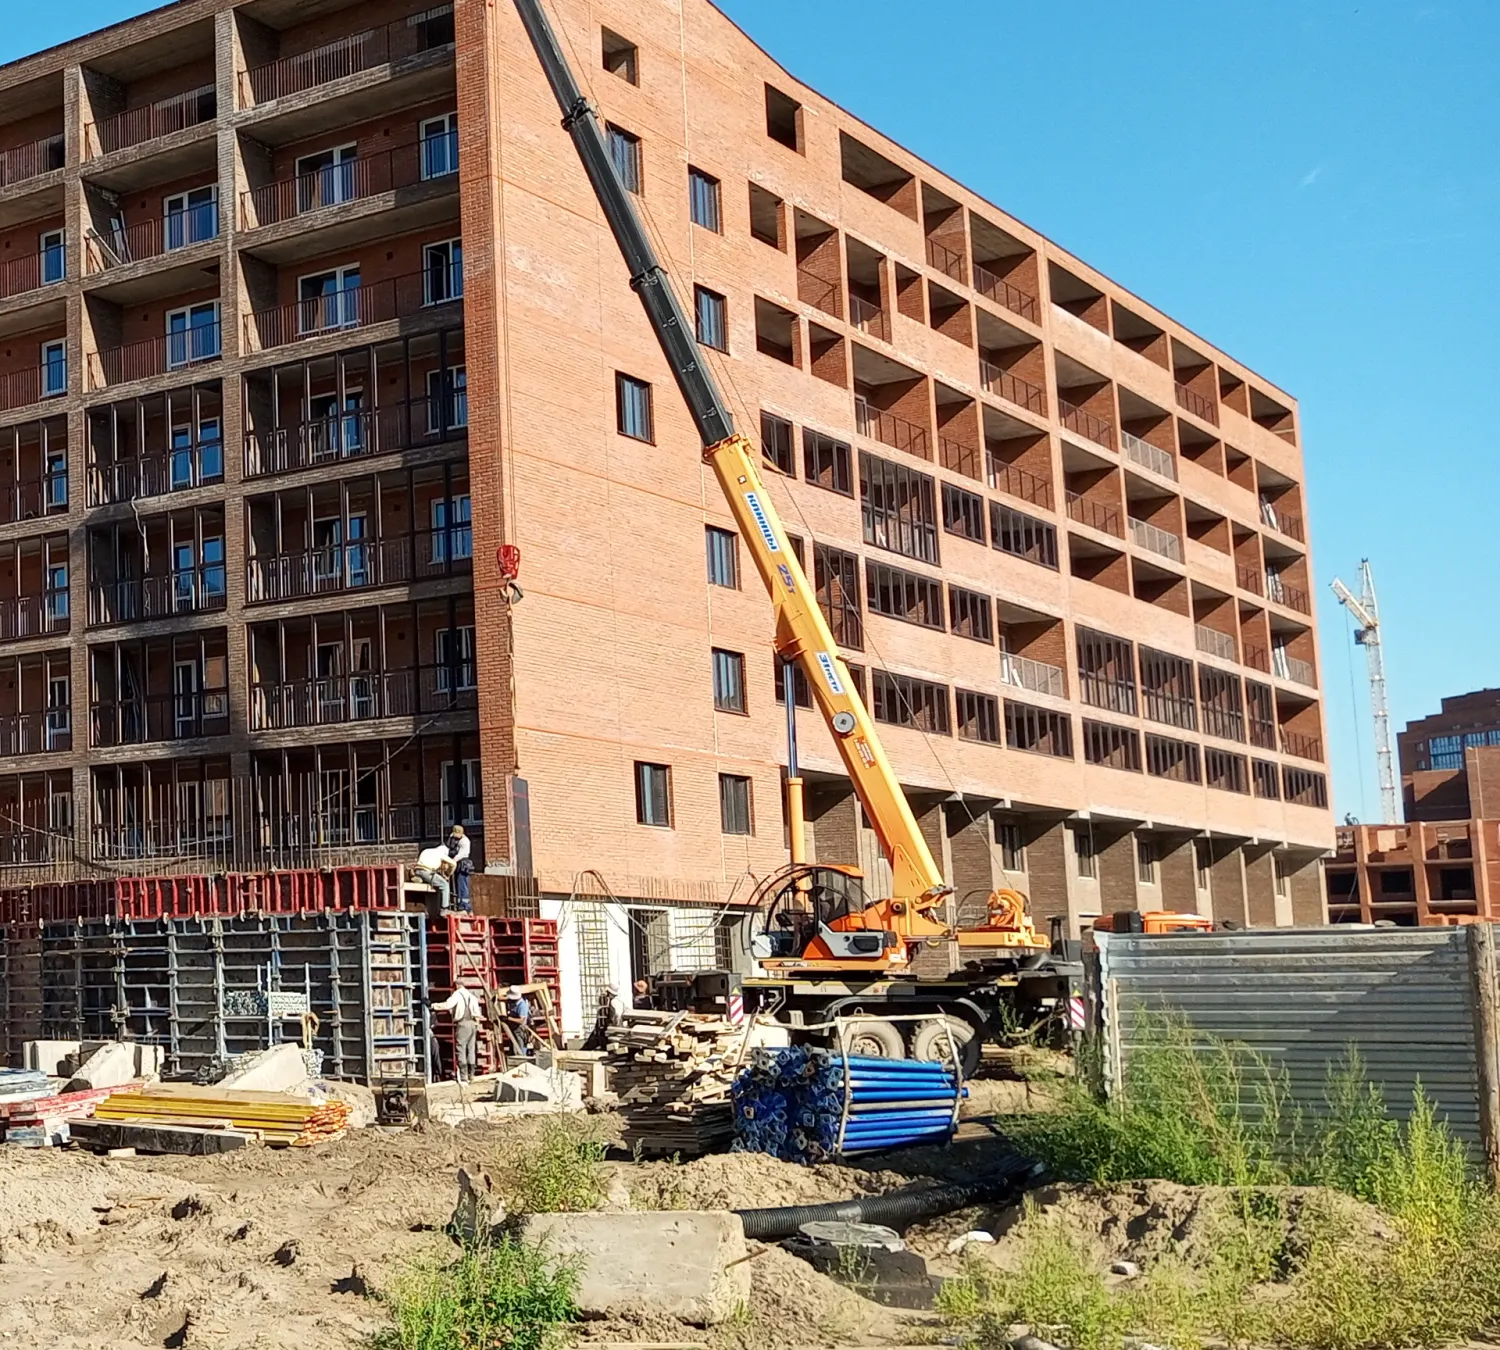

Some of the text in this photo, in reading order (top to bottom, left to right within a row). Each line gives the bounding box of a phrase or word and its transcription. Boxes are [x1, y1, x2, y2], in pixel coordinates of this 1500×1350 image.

[668, 316, 677, 326] 13
[686, 361, 696, 372] 16
[707, 406, 717, 417] 19
[747, 494, 777, 550] КЛИНЦЫ
